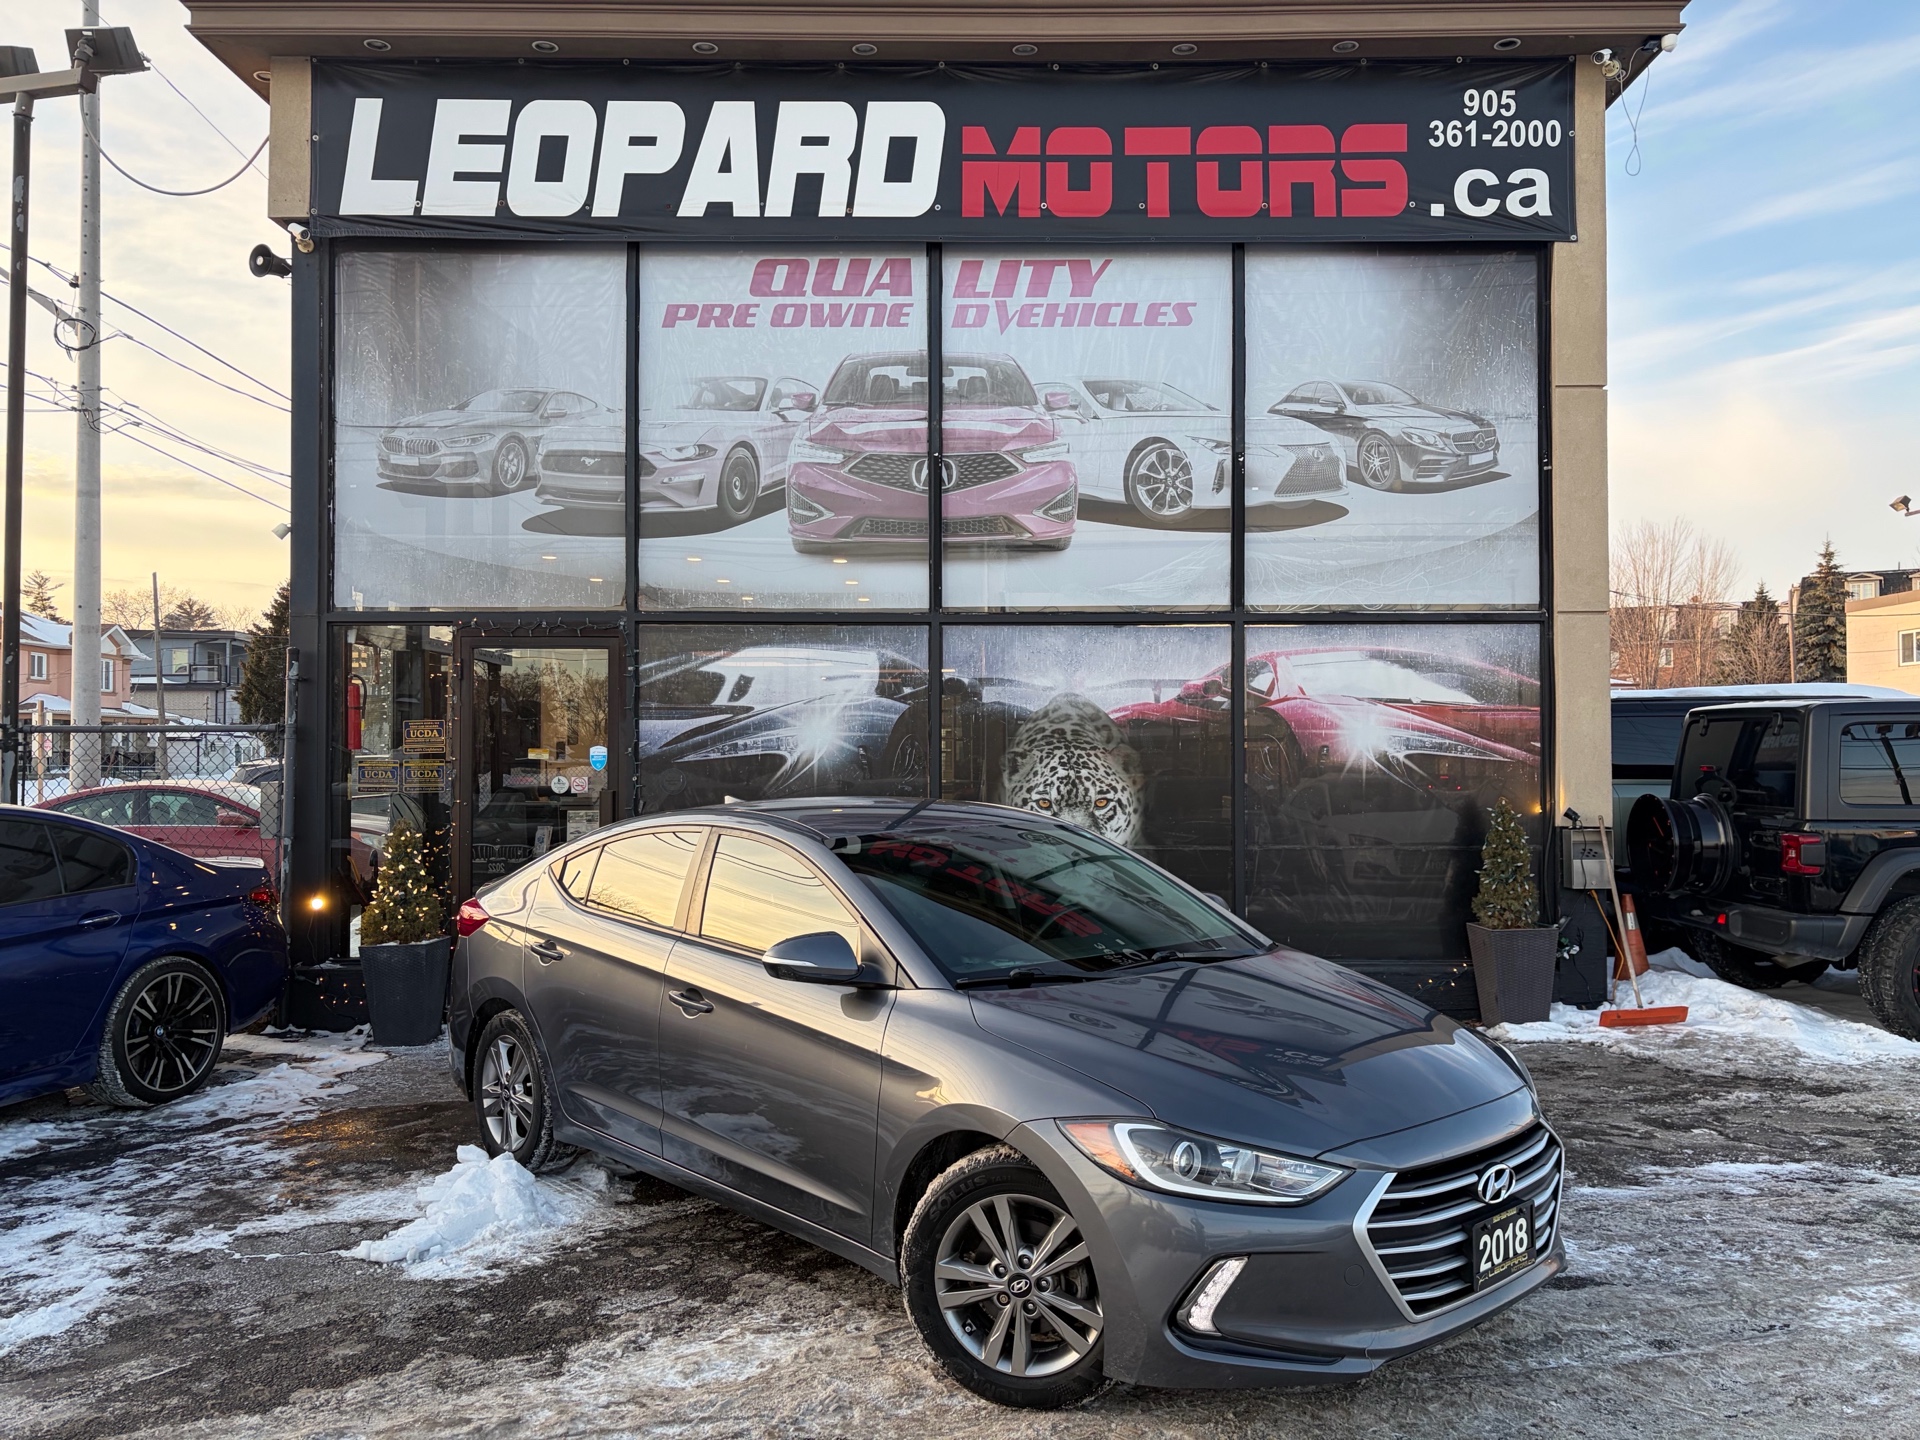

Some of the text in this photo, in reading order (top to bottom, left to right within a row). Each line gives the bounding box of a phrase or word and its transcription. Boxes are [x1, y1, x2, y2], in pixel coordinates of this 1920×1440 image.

[1464, 89, 1517, 117] 905
[1429, 119, 1562, 148] 361-2000
[338, 97, 1553, 218] LEOPARD MOTORS .ca
[661, 303, 758, 329] PRE
[410, 729, 439, 738] UCDA
[364, 770, 393, 779] UCDA
[410, 770, 439, 778] UCDA
[929, 1174, 988, 1222] SOLUS
[1479, 1217, 1528, 1273] 2018
[1488, 1252, 1528, 1277] LEOPARD
